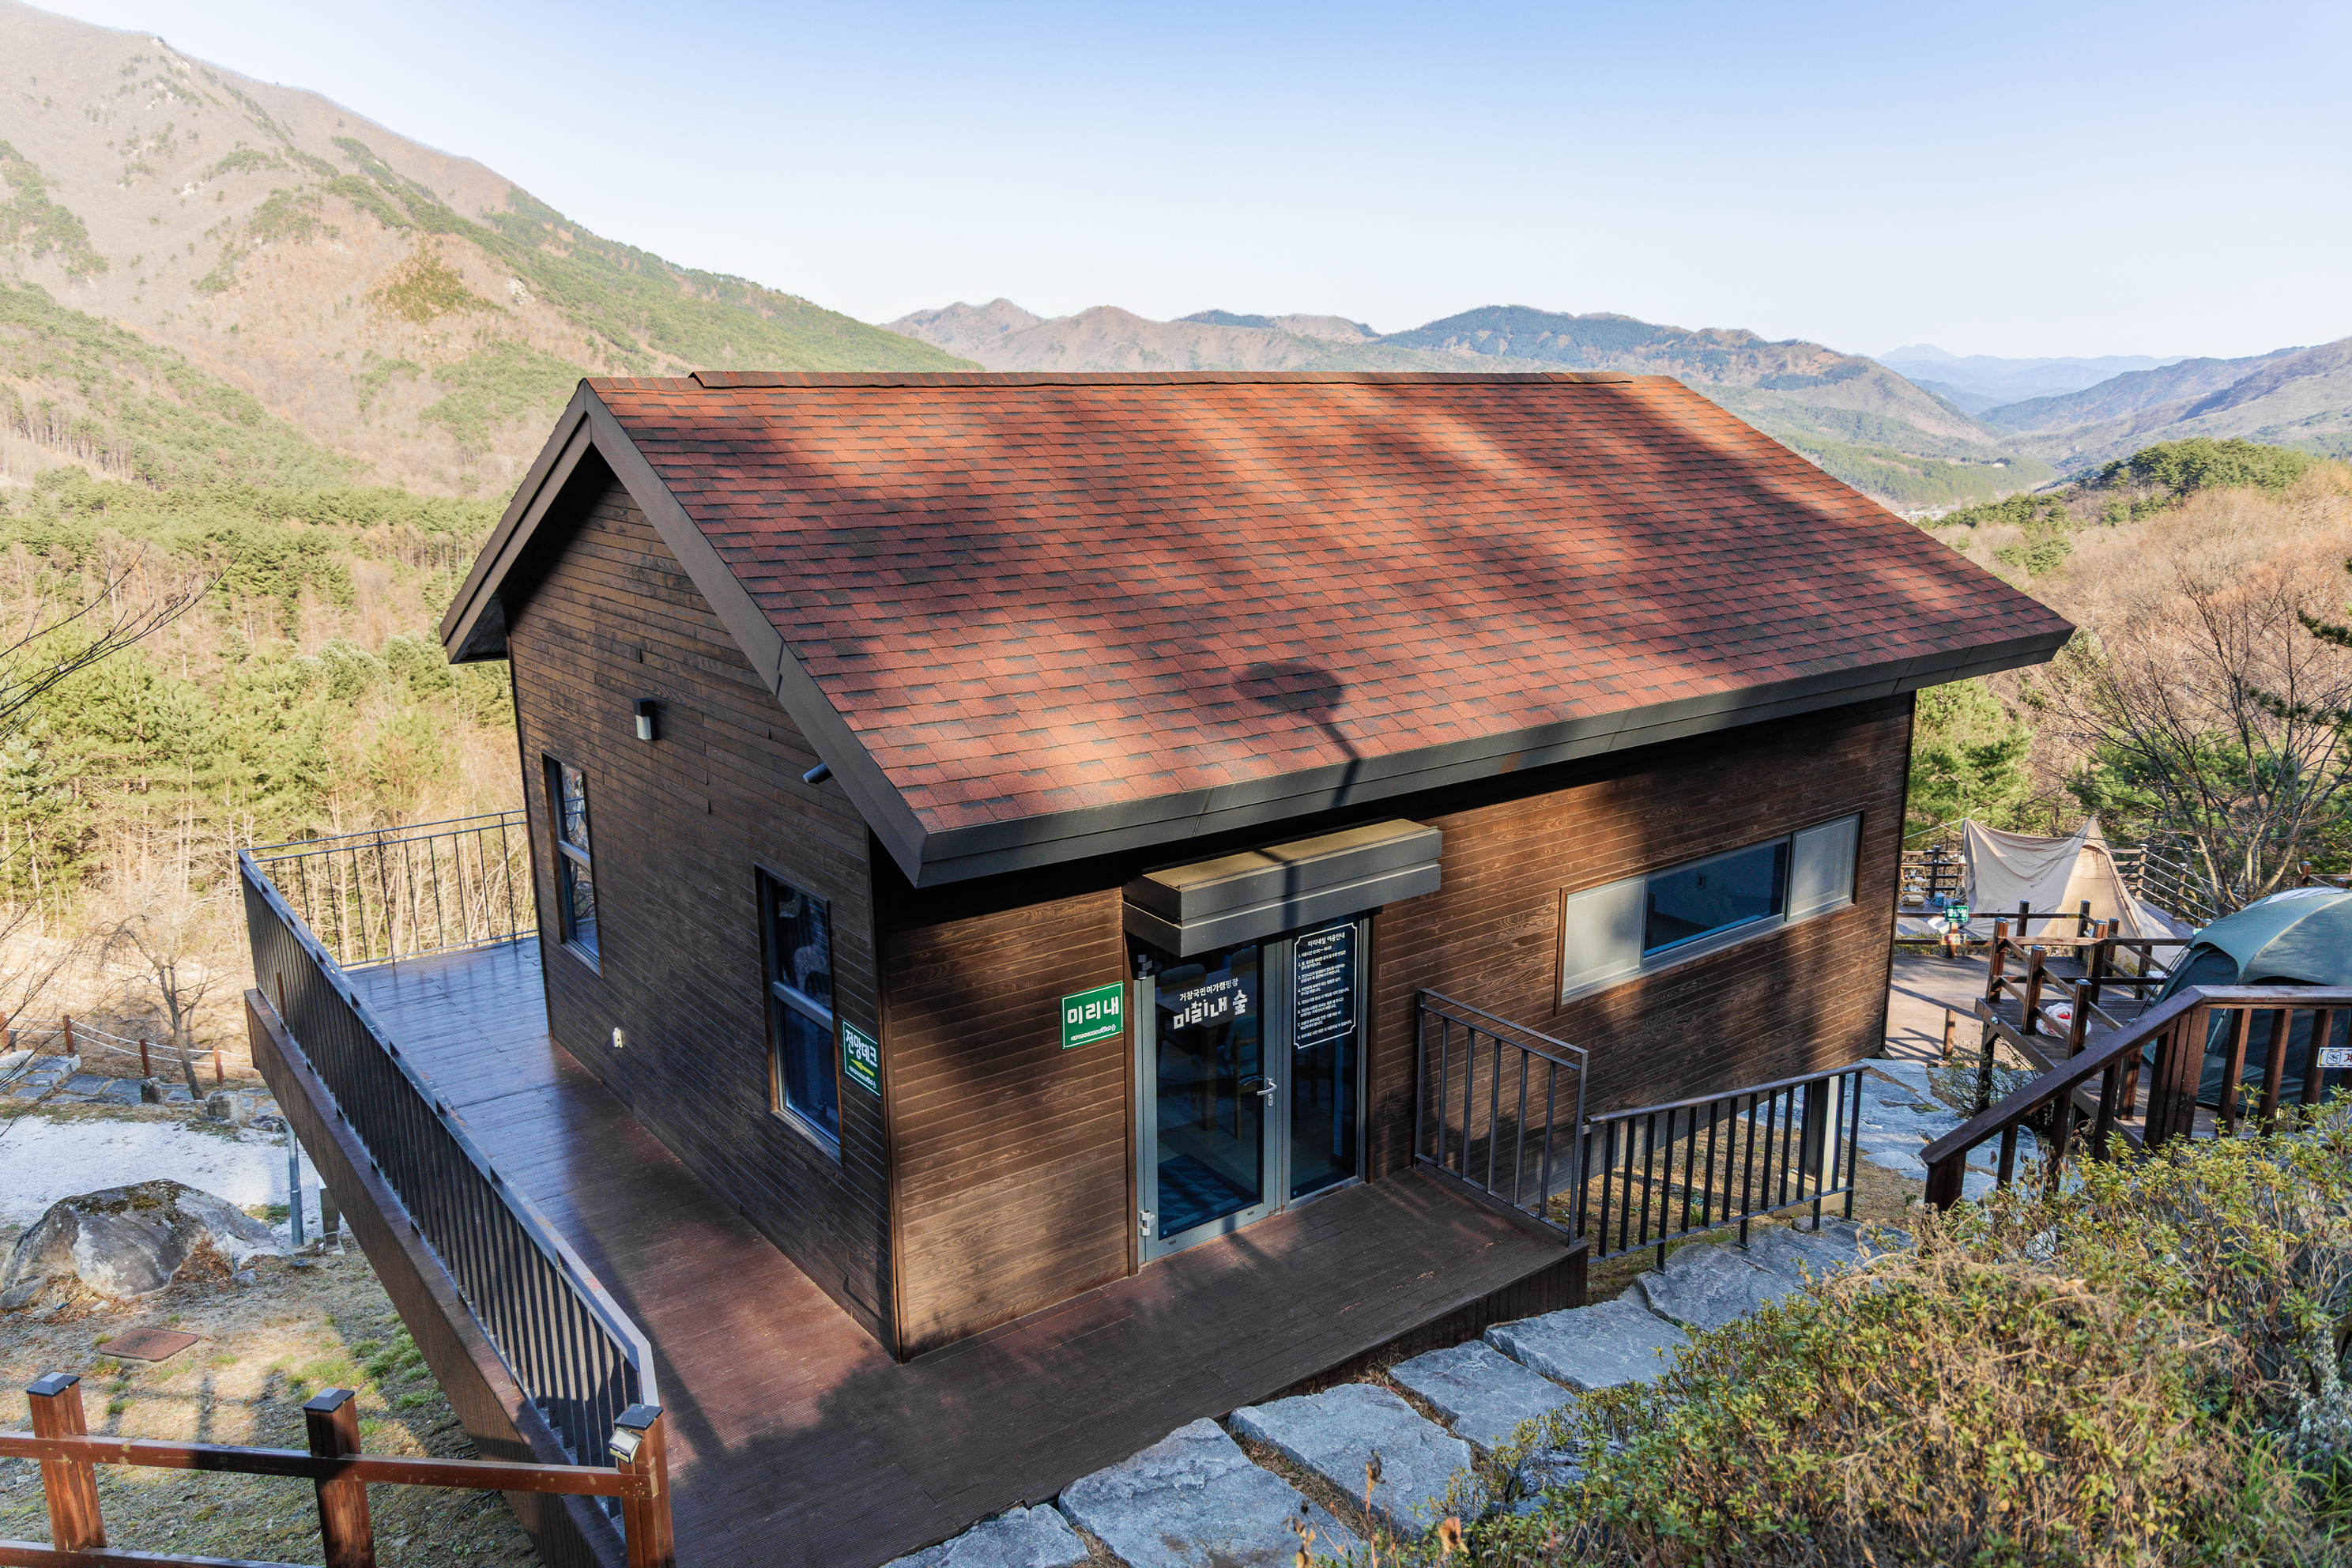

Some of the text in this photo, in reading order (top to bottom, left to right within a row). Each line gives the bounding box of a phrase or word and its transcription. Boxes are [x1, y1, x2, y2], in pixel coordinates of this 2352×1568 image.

[1307, 932, 1345, 947] 미리내실 이용안내
[1179, 978, 1238, 1001] 거창국민여가캠핑장
[1067, 996, 1119, 1024] 미리내
[1174, 989, 1248, 1030] 미리내 숲
[845, 1029, 878, 1068] 전망데크
